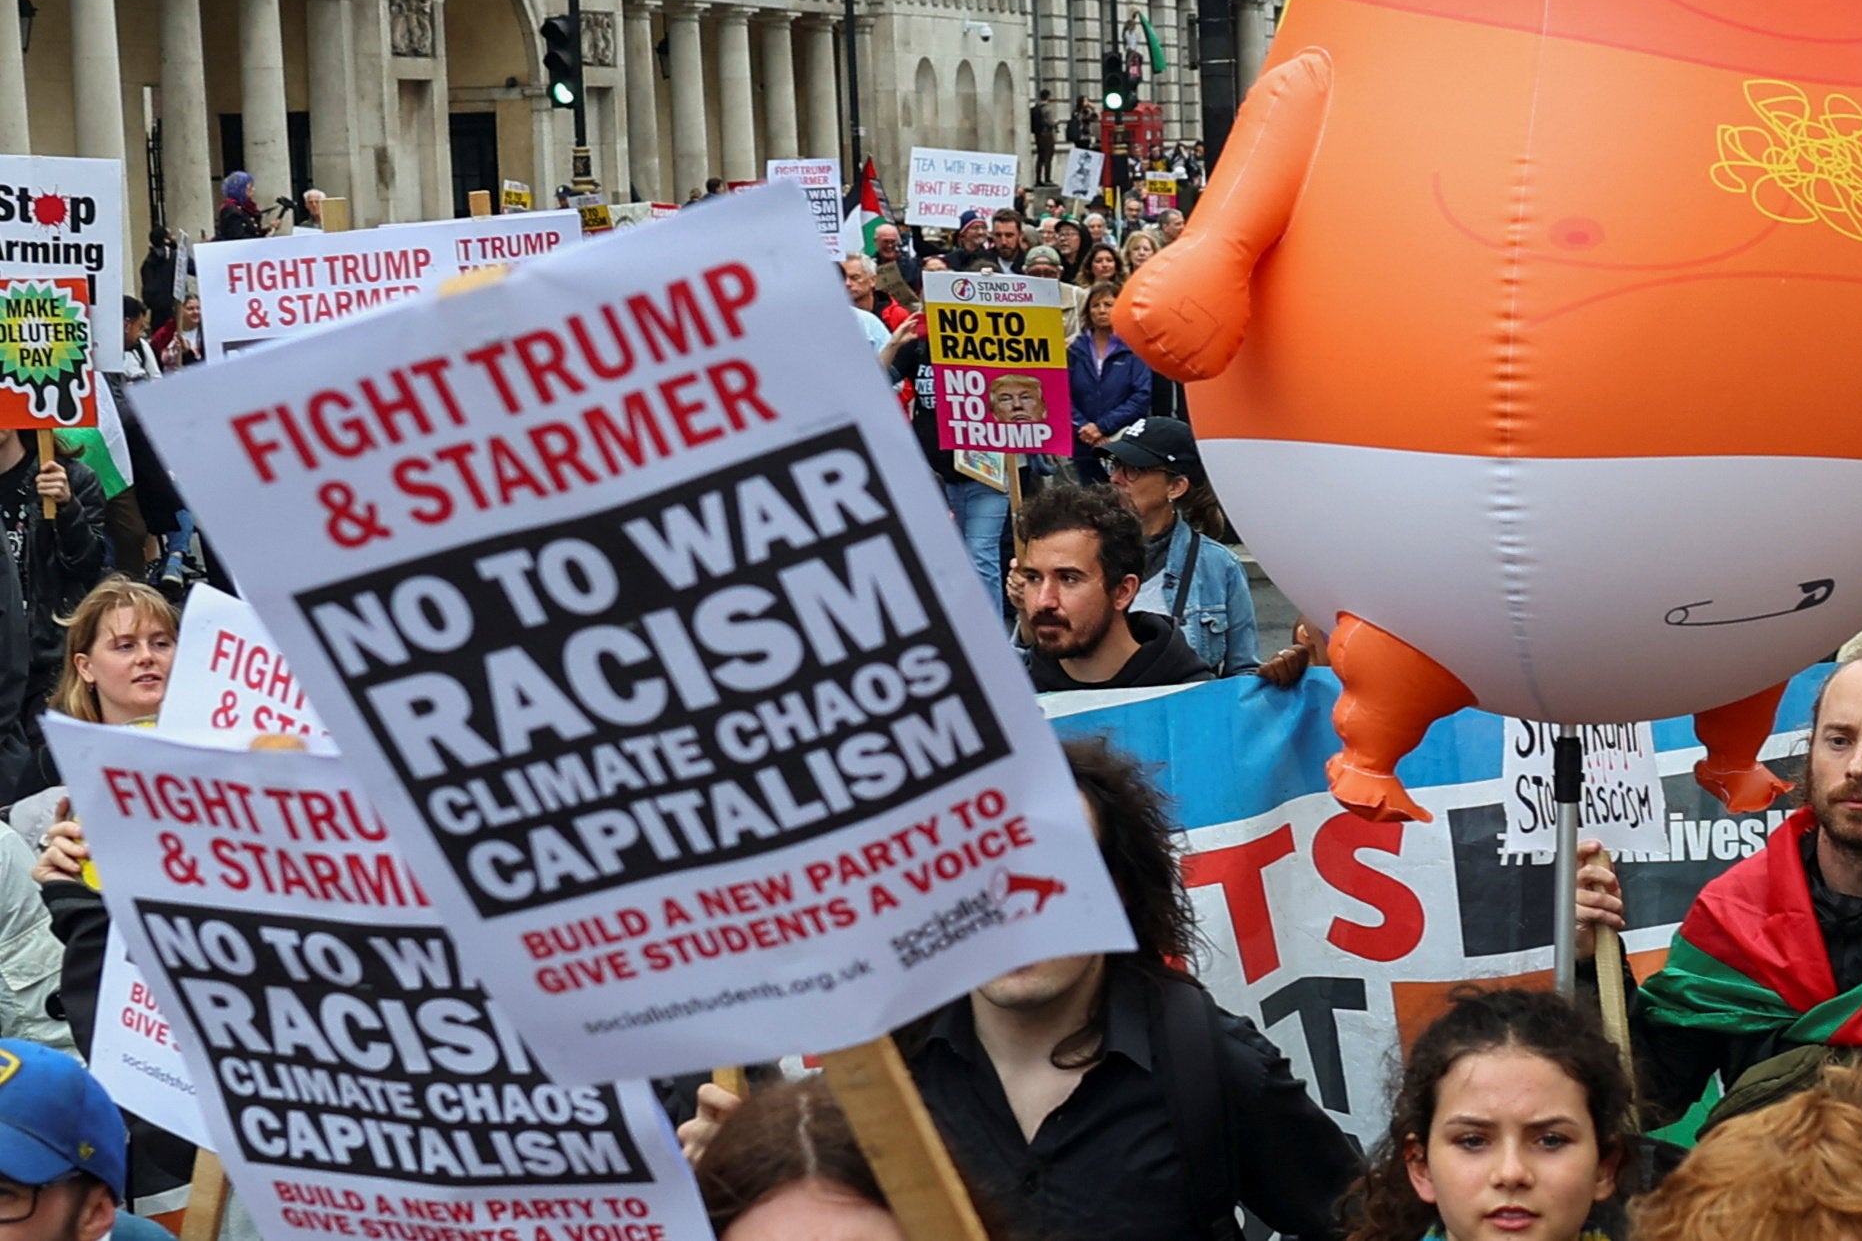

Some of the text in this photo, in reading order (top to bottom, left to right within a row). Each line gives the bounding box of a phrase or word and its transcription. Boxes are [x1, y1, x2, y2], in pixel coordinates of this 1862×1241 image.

[774, 165, 832, 175] FIGHT TRUMP
[914, 158, 935, 172] TEA
[808, 188, 835, 199] WAR
[0, 237, 104, 271] rming
[227, 248, 431, 294] FIGHT TRUMP
[977, 281, 1027, 292] STAND UP
[979, 292, 1033, 303] TO RACISM
[6, 298, 61, 318] MAKE
[938, 309, 1025, 336] NO TO
[0, 322, 88, 343] OLLUTERS
[941, 335, 1050, 362] RACISM
[19, 347, 54, 367] PAY
[230, 260, 760, 486] FIGHT TRUMP
[944, 370, 986, 396] NO
[946, 396, 986, 421] TO
[316, 358, 779, 550] & STARMER
[949, 421, 1053, 448] TRUMP
[311, 448, 893, 679] NO TO WAR
[365, 534, 932, 779] RACISM
[426, 644, 952, 837] CLIMATE CHAOS
[102, 766, 266, 834] FIGHT
[467, 698, 985, 902] CAPITALISM
[161, 831, 206, 887] &
[521, 787, 1009, 961] BUILD NEW PARTY TO
[534, 952, 639, 996] GIVE
[644, 896, 860, 972] STUDENTS
[902, 816, 1036, 895] VOICE
[143, 913, 257, 976] NO
[258, 925, 364, 988] TO
[219, 1056, 611, 1125] CLIMATE CHAOS
[240, 1104, 633, 1177] CAPITALISM
[273, 1180, 650, 1224] BUILD A NEW PARTY TO
[361, 1216, 666, 1241] STUDENTS VOICE
